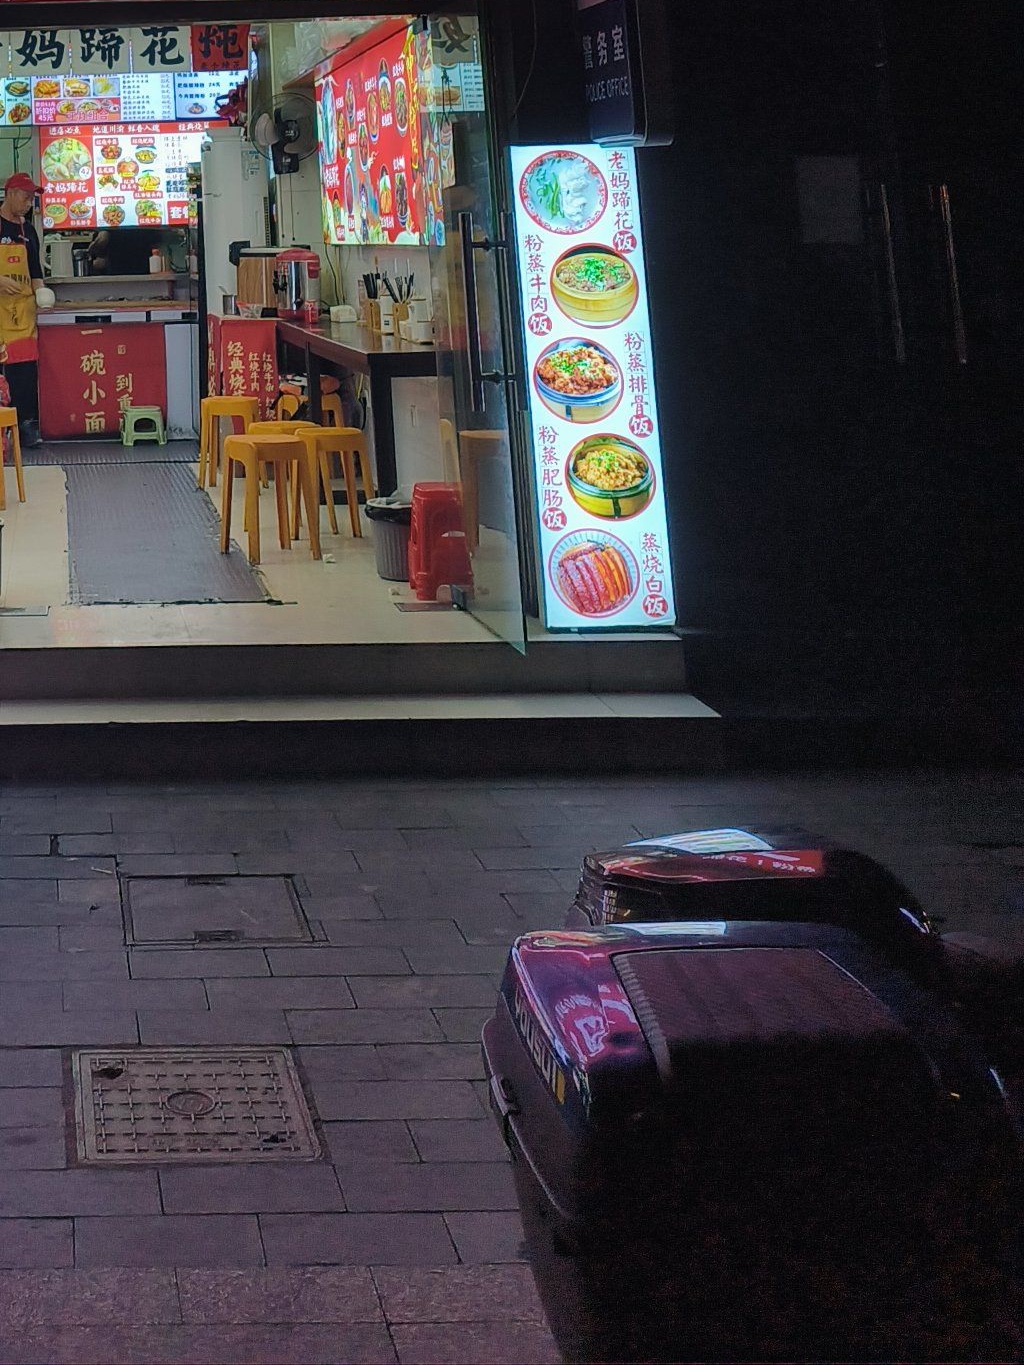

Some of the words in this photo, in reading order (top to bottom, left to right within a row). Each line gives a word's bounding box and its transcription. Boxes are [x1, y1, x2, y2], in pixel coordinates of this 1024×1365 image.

[582, 24, 625, 70] 警务室
[608, 150, 637, 253] 老妈蹄花饭
[79, 328, 107, 434] 一碗小面
[624, 332, 653, 438] 粉蒸排骨饭
[538, 425, 567, 531] 粉蒸肥肠饭
[642, 532, 668, 618] 蒸烧白饭
